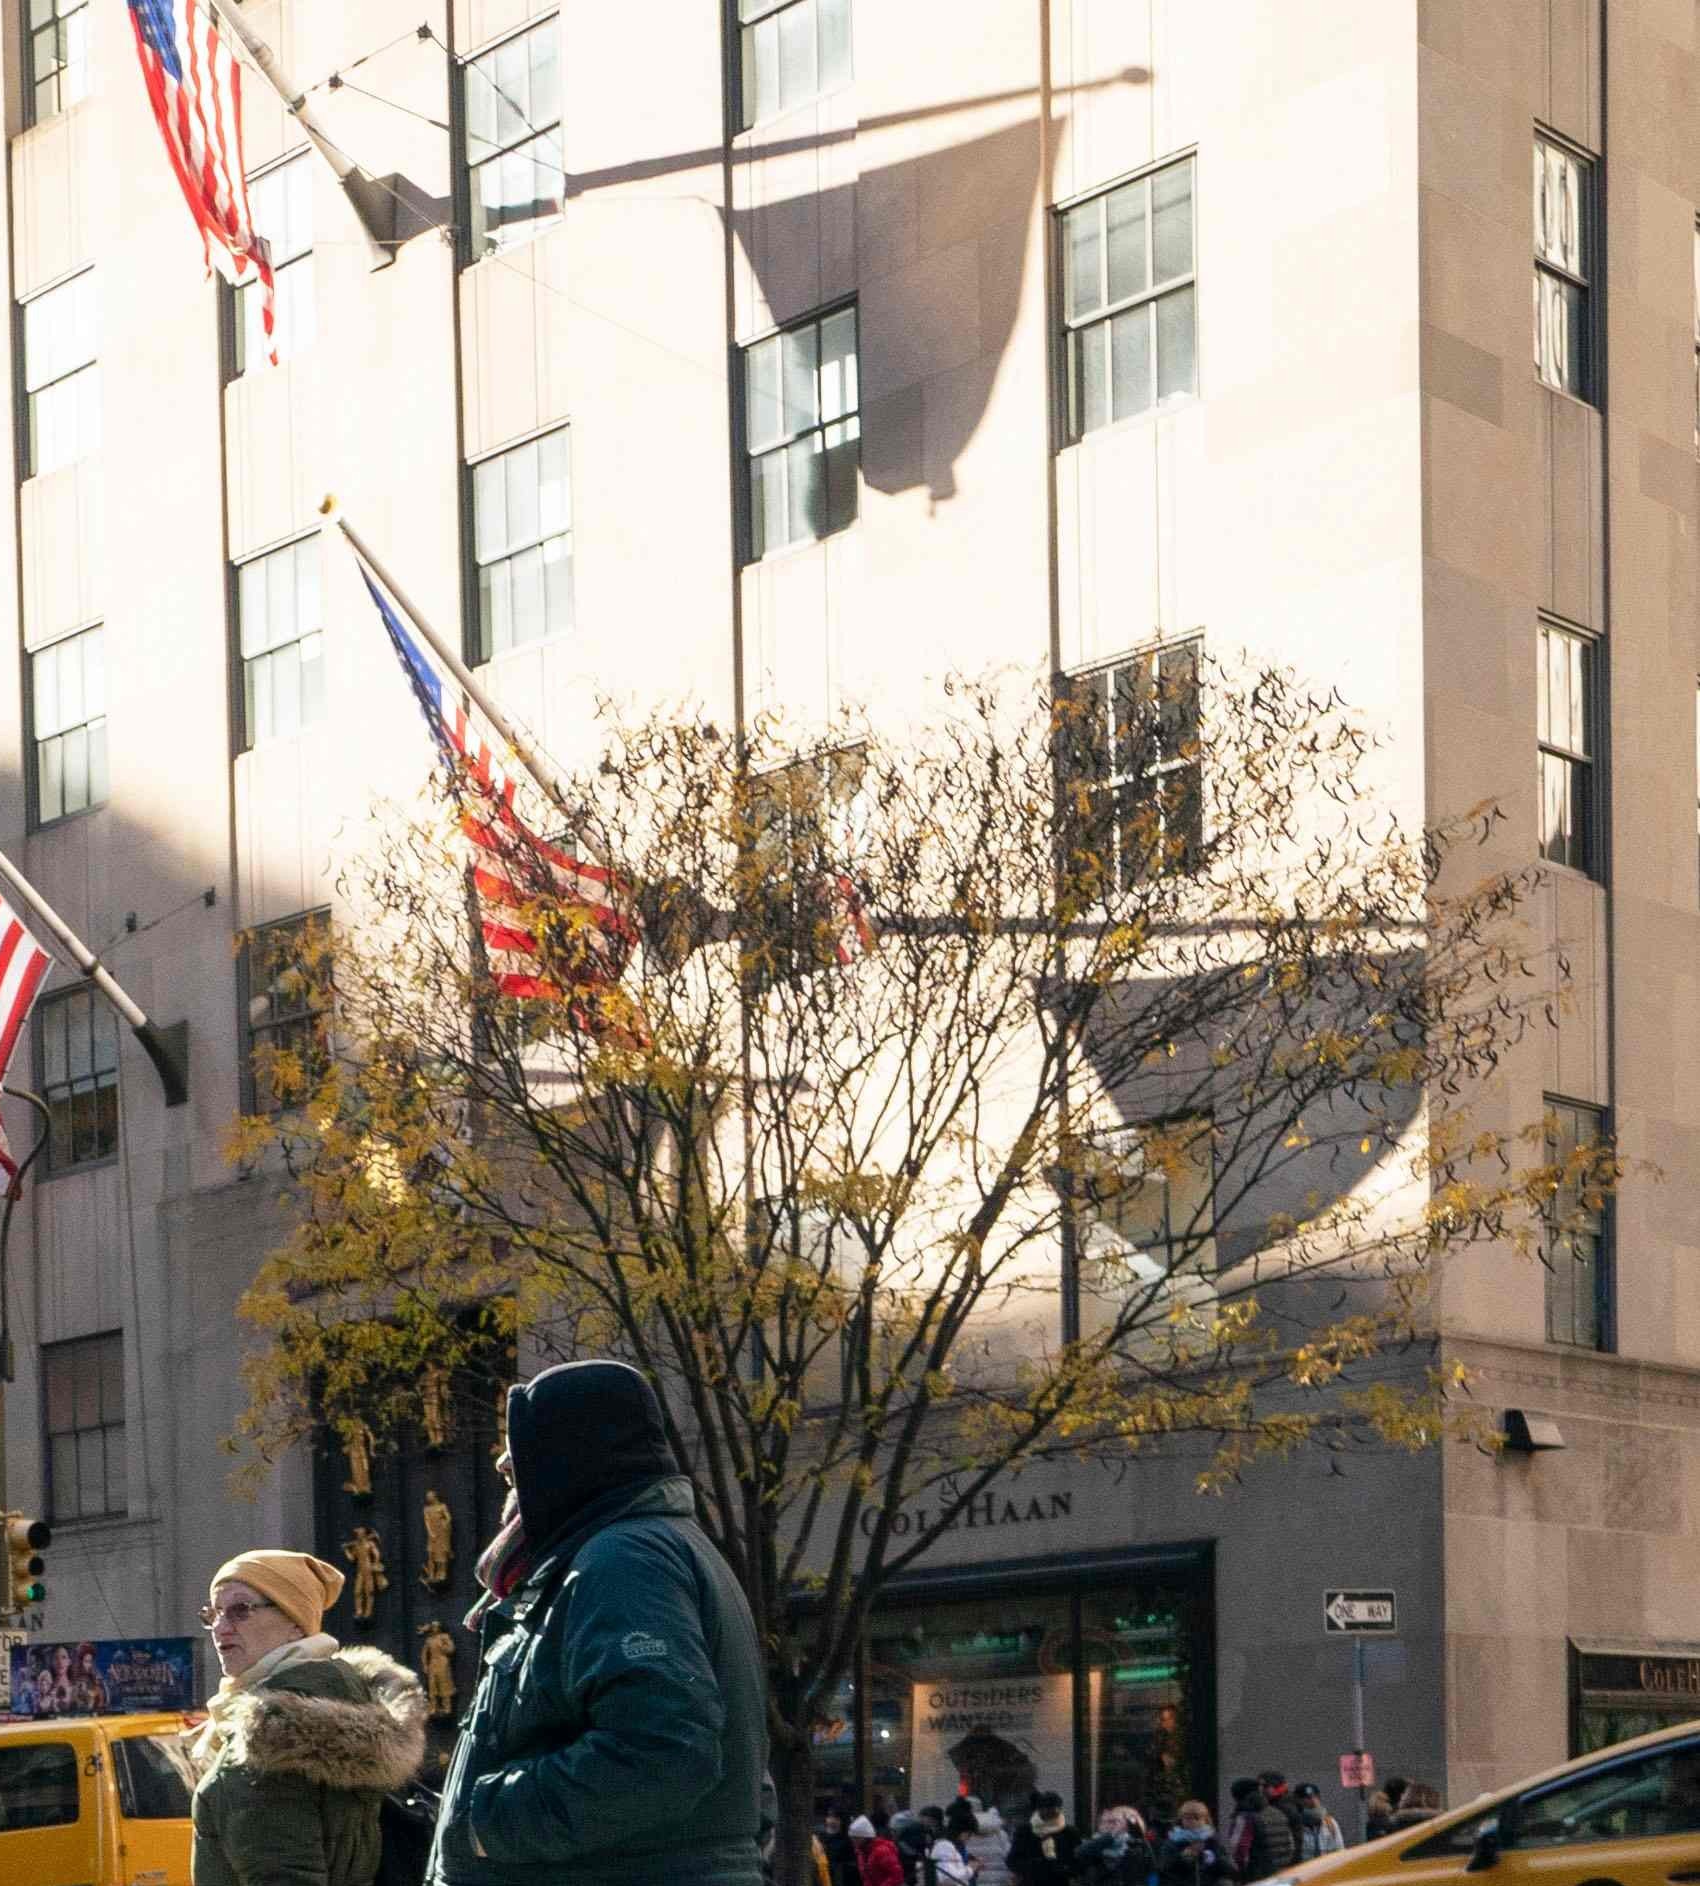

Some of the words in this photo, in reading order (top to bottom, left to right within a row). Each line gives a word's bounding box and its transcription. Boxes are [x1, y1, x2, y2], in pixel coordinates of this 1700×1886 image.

[964, 1491, 1073, 1530] HAAN
[1334, 1603, 1356, 1619] ONE
[1367, 1603, 1389, 1618] WAY
